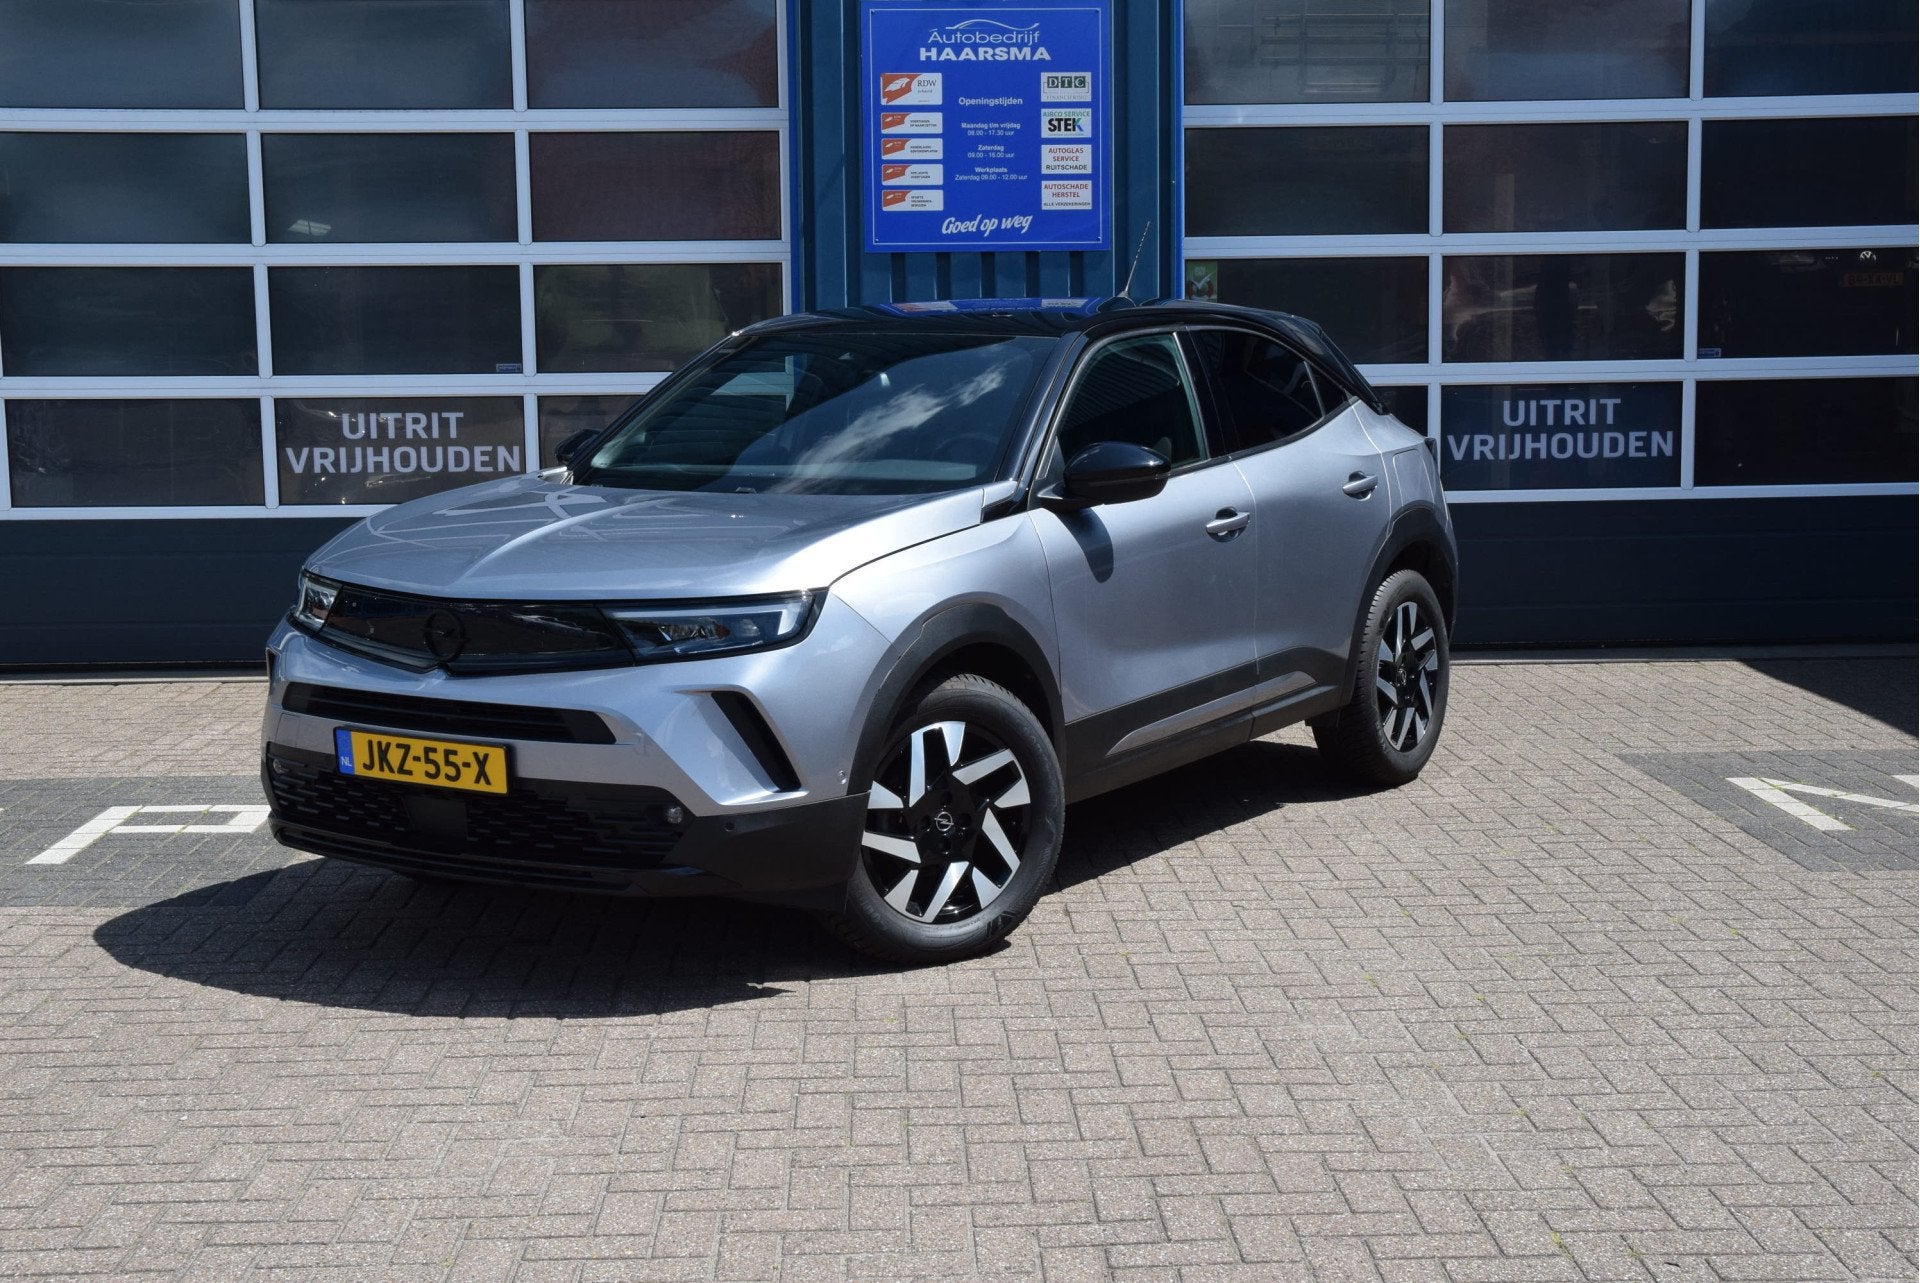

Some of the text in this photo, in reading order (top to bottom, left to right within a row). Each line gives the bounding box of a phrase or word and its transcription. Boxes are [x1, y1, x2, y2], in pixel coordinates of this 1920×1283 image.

[928, 31, 1040, 45] Autobedrijf
[919, 46, 1052, 61] HAARSMA
[917, 79, 937, 87] RDW
[1047, 76, 1086, 88] DTC
[958, 97, 1024, 106] Openingstijden
[1047, 117, 1084, 132] STEK
[942, 214, 1034, 238] Goed op weg
[1502, 398, 1622, 427] UITRIT
[341, 411, 464, 440] UITRIT
[1446, 430, 1674, 461] VRIJHOUDEN
[285, 445, 521, 474] VRIJHOUDEN
[341, 739, 492, 786] NL JKZ-55-X
